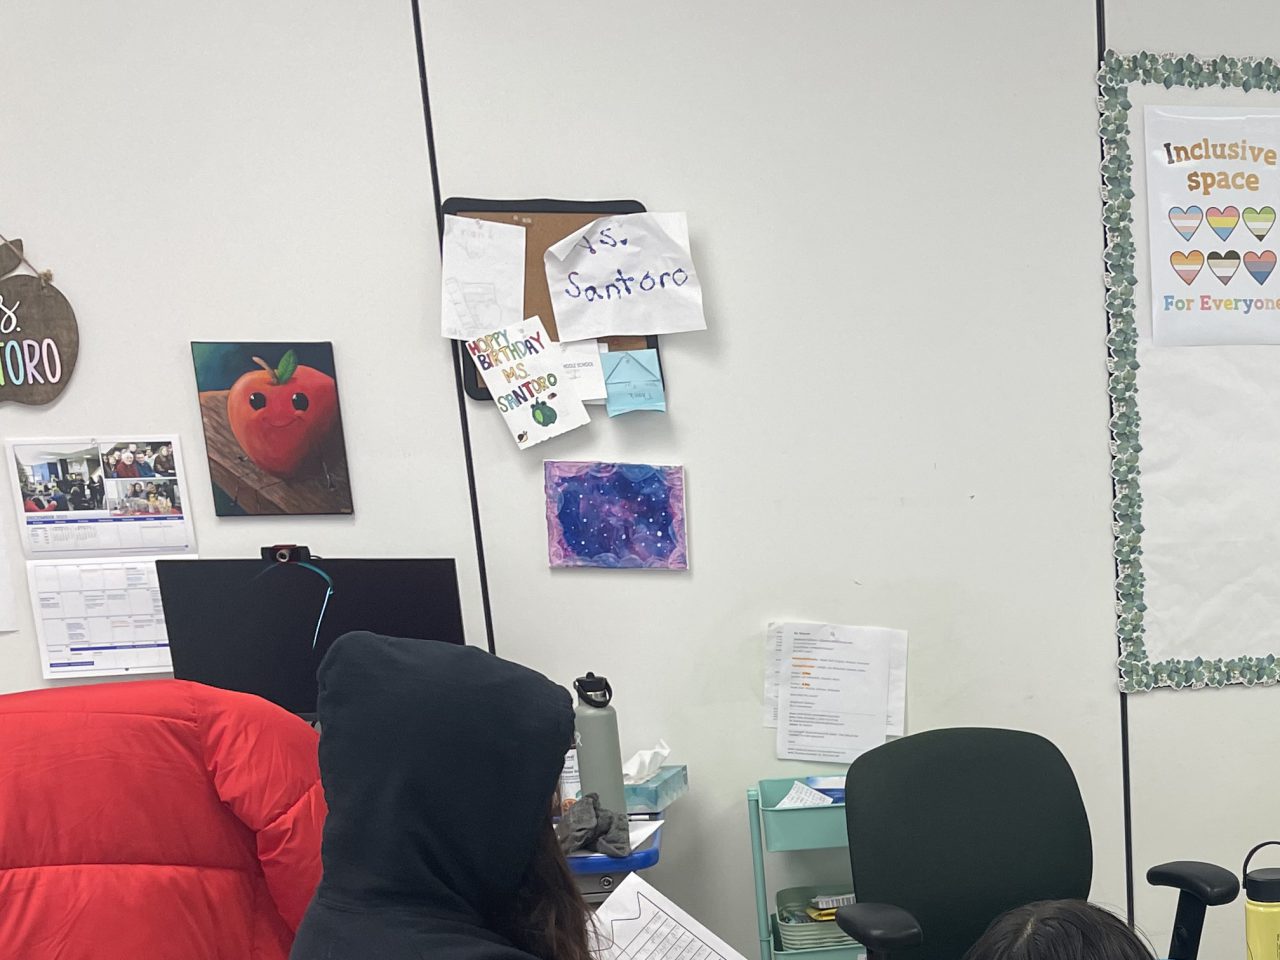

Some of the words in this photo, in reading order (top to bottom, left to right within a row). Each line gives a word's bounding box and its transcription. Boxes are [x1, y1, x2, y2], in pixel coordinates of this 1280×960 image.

[1163, 138, 1278, 165] Inclusive
[1187, 171, 1260, 195] space
[565, 267, 689, 302] Santoro
[1164, 295, 1195, 311] For
[477, 331, 545, 371] BIRTHDAY
[497, 373, 558, 413] SANTORO
